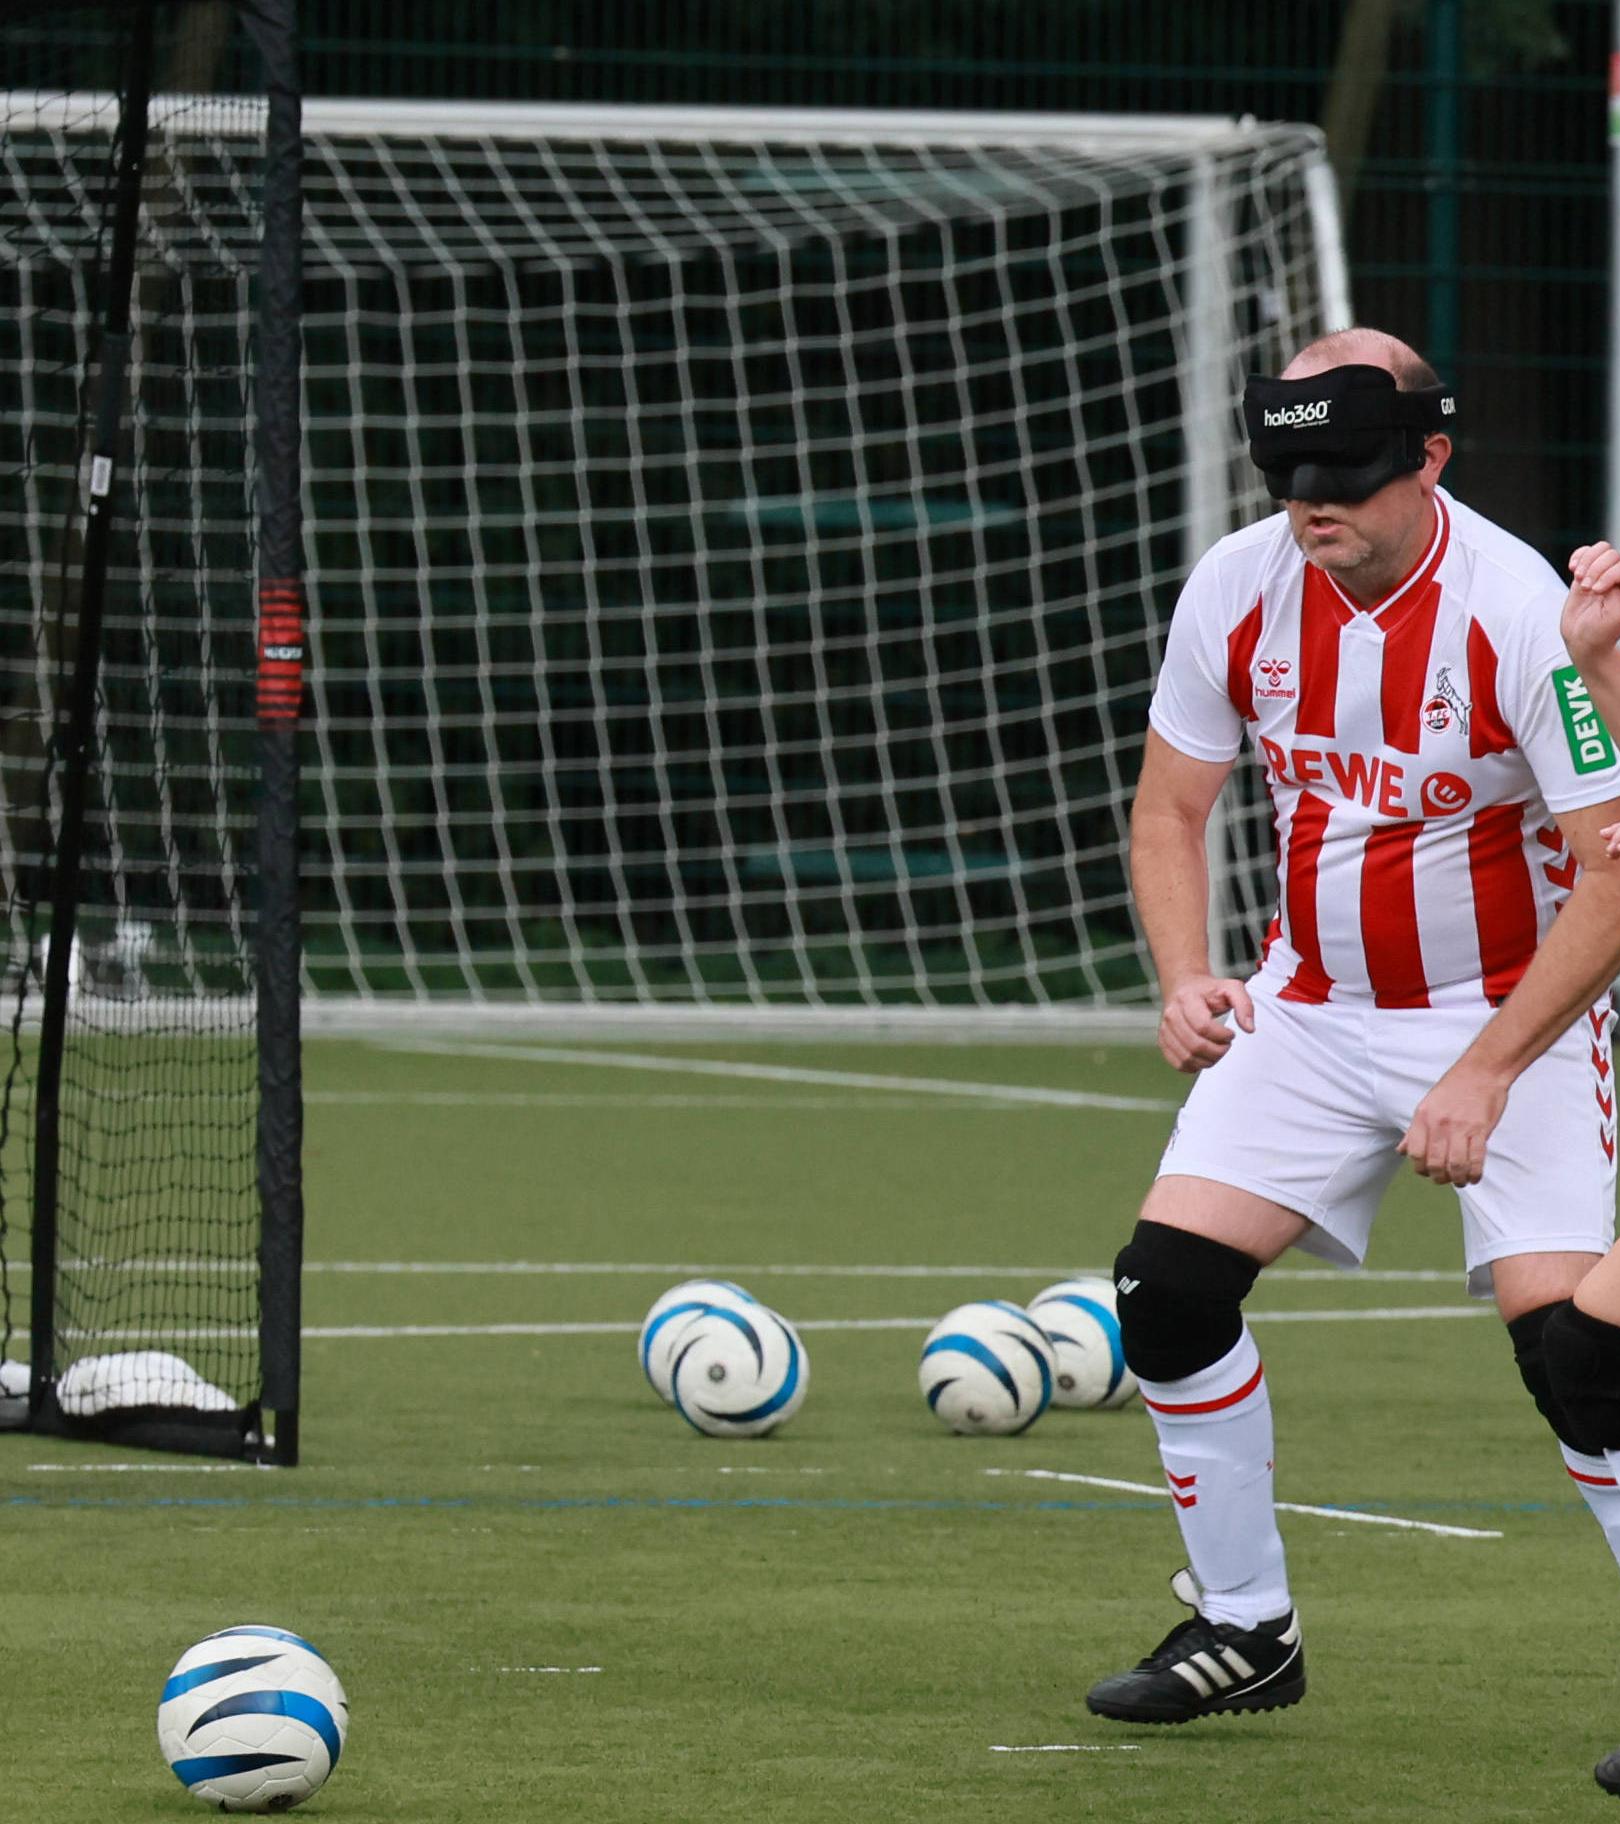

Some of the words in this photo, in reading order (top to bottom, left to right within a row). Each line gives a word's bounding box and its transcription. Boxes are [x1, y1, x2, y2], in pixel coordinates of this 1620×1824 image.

[1264, 400, 1328, 427] halo360
[1563, 676, 1606, 765] DEVK
[1259, 735, 1409, 818] REWE
